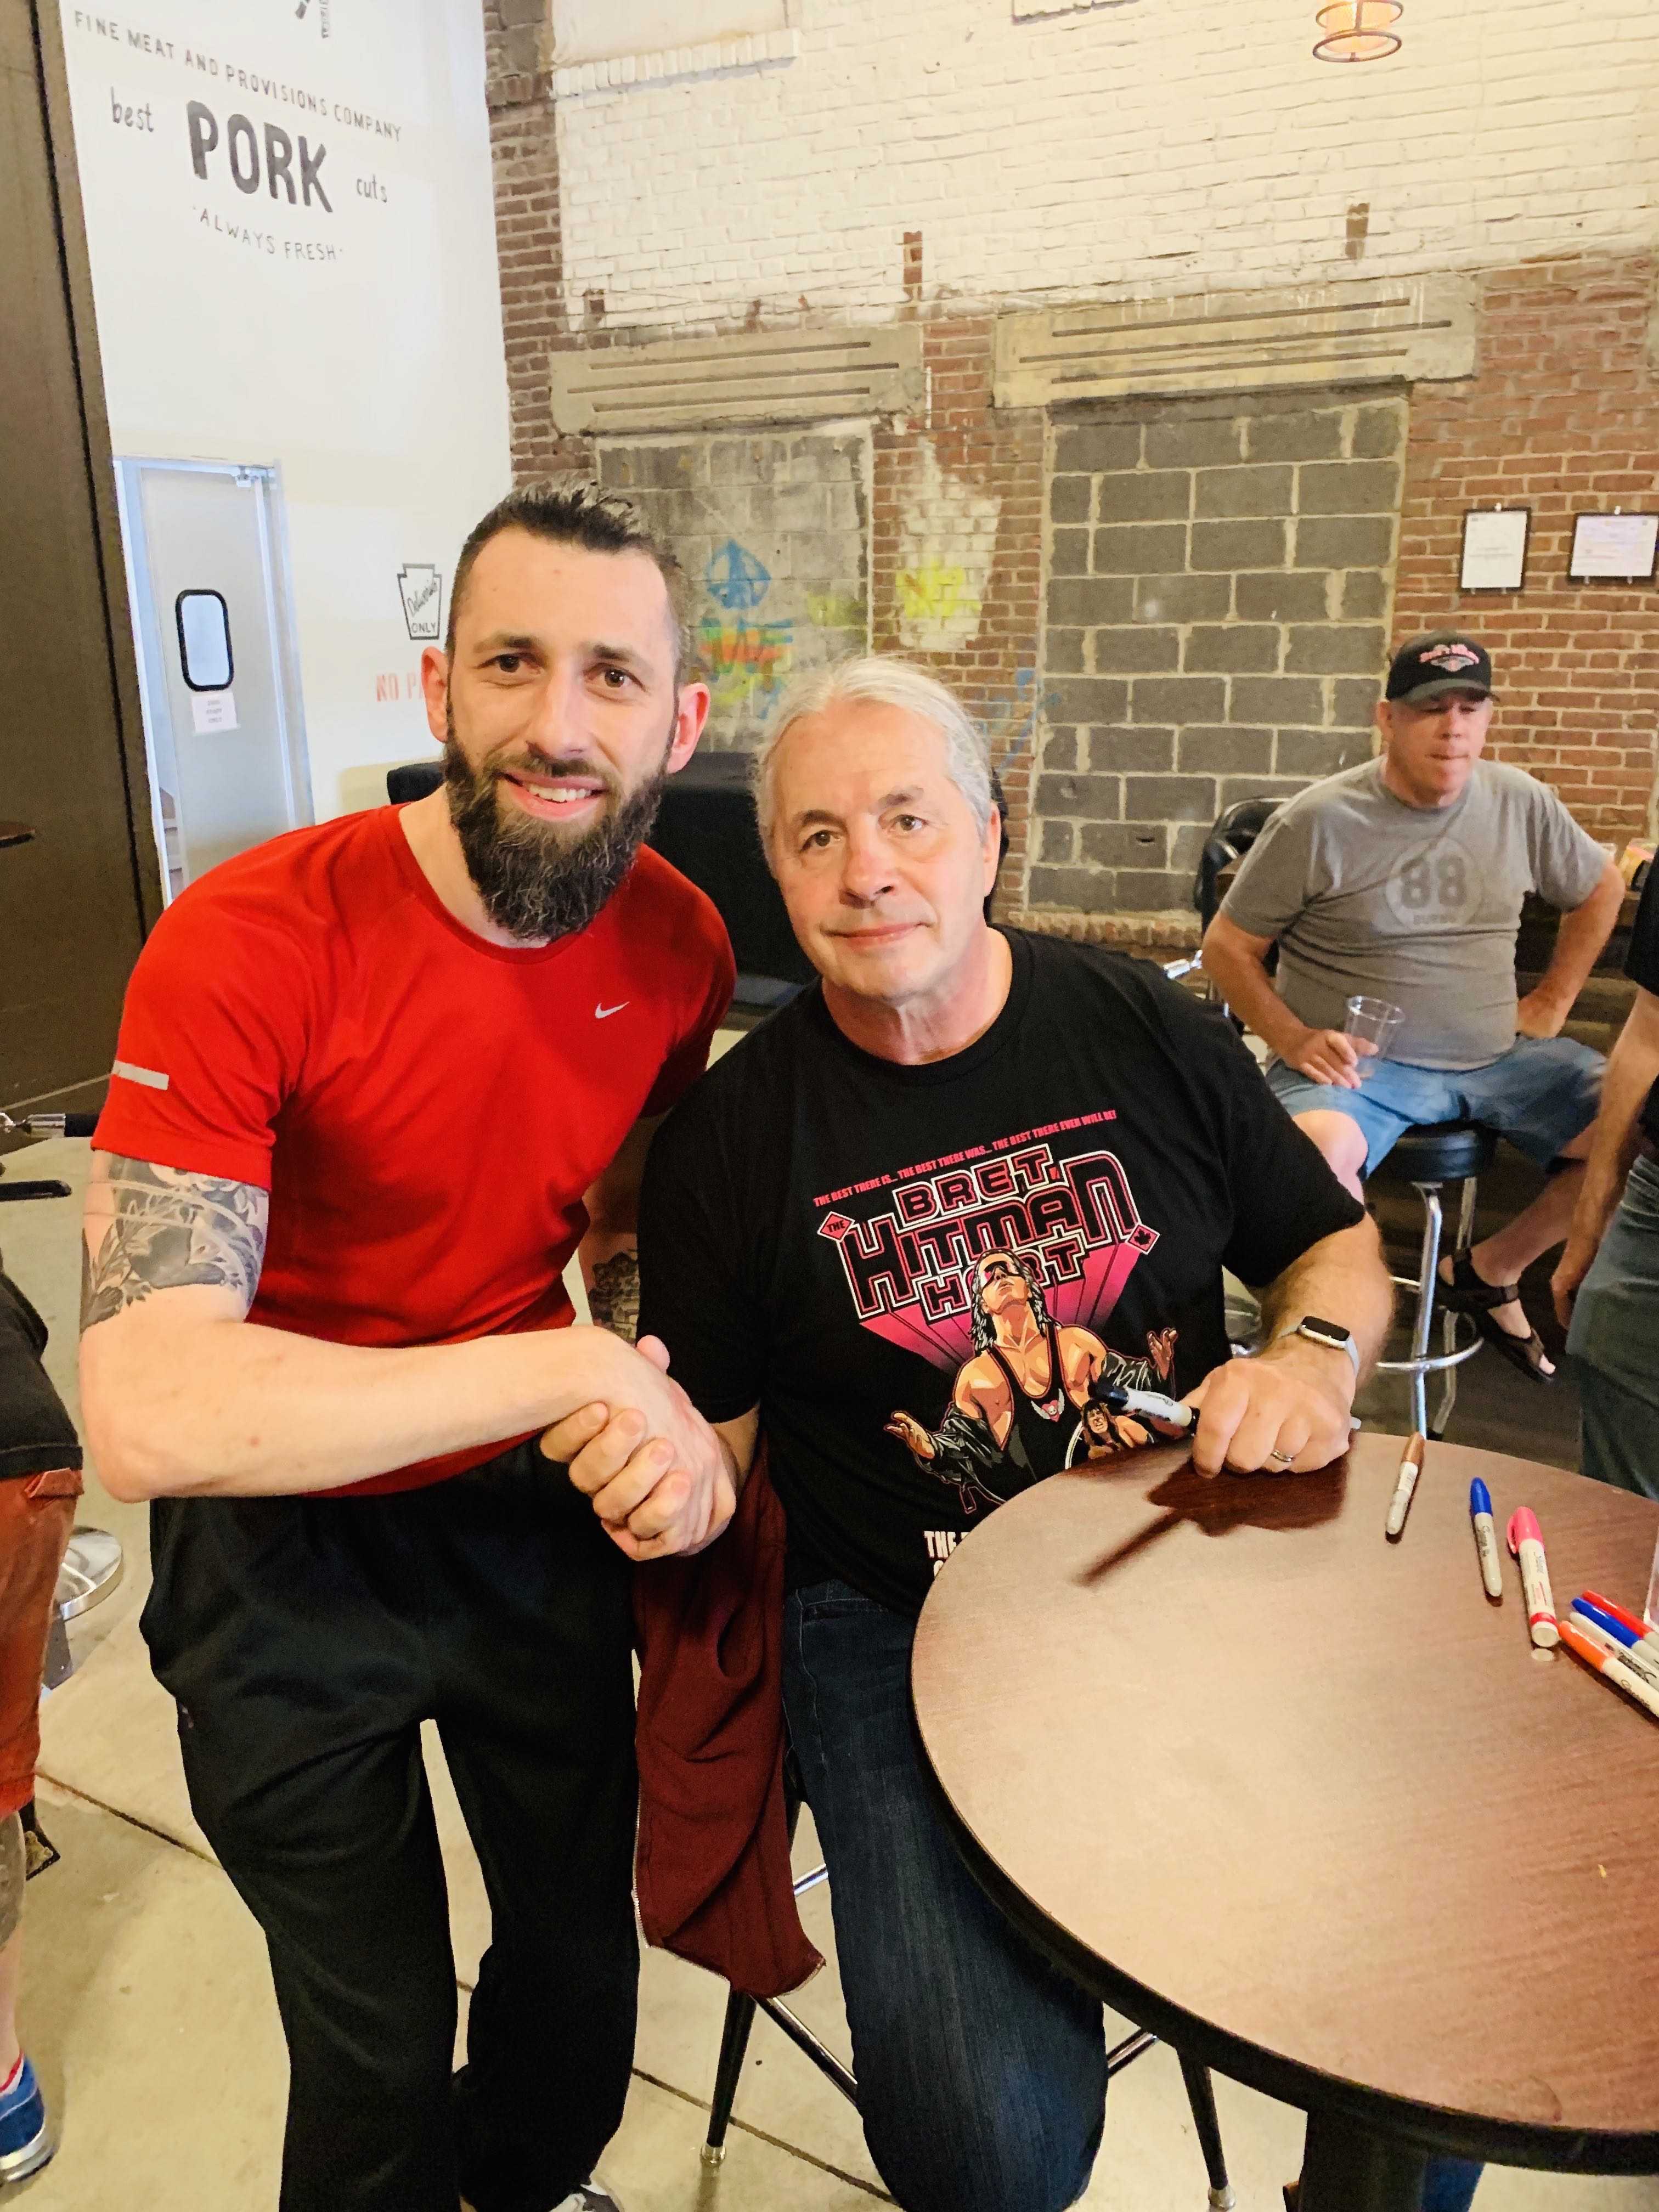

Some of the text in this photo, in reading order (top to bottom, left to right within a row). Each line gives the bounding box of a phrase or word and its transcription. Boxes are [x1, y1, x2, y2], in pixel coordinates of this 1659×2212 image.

[74, 10, 402, 142] FINE MEAT AND PROVISIONS COMPANY
[110, 86, 387, 213] best PORK cuts
[200, 208, 337, 260] ALWAYS FRESH
[411, 622, 437, 633] ONLY
[376, 673, 399, 703] NO
[1401, 855, 1468, 910] 88
[812, 1194, 831, 1207] THE
[831, 1187, 853, 1201] BEST
[854, 1177, 881, 1194] THERE
[897, 1166, 916, 1179] THE
[915, 1160, 938, 1175] BEST
[937, 1152, 966, 1167] THERE
[991, 1137, 1010, 1150] THE
[1009, 1131, 1032, 1146] BEST
[1031, 1123, 1060, 1138] THERE
[1059, 1118, 1082, 1131] EVER
[1081, 1111, 1104, 1125] WILL
[892, 1143, 1053, 1228] BRET
[826, 1220, 846, 1233] THE
[836, 1150, 1142, 1320] HITMAN
[917, 1231, 1086, 1321] HRT
[924, 1531, 957, 1558] THE
